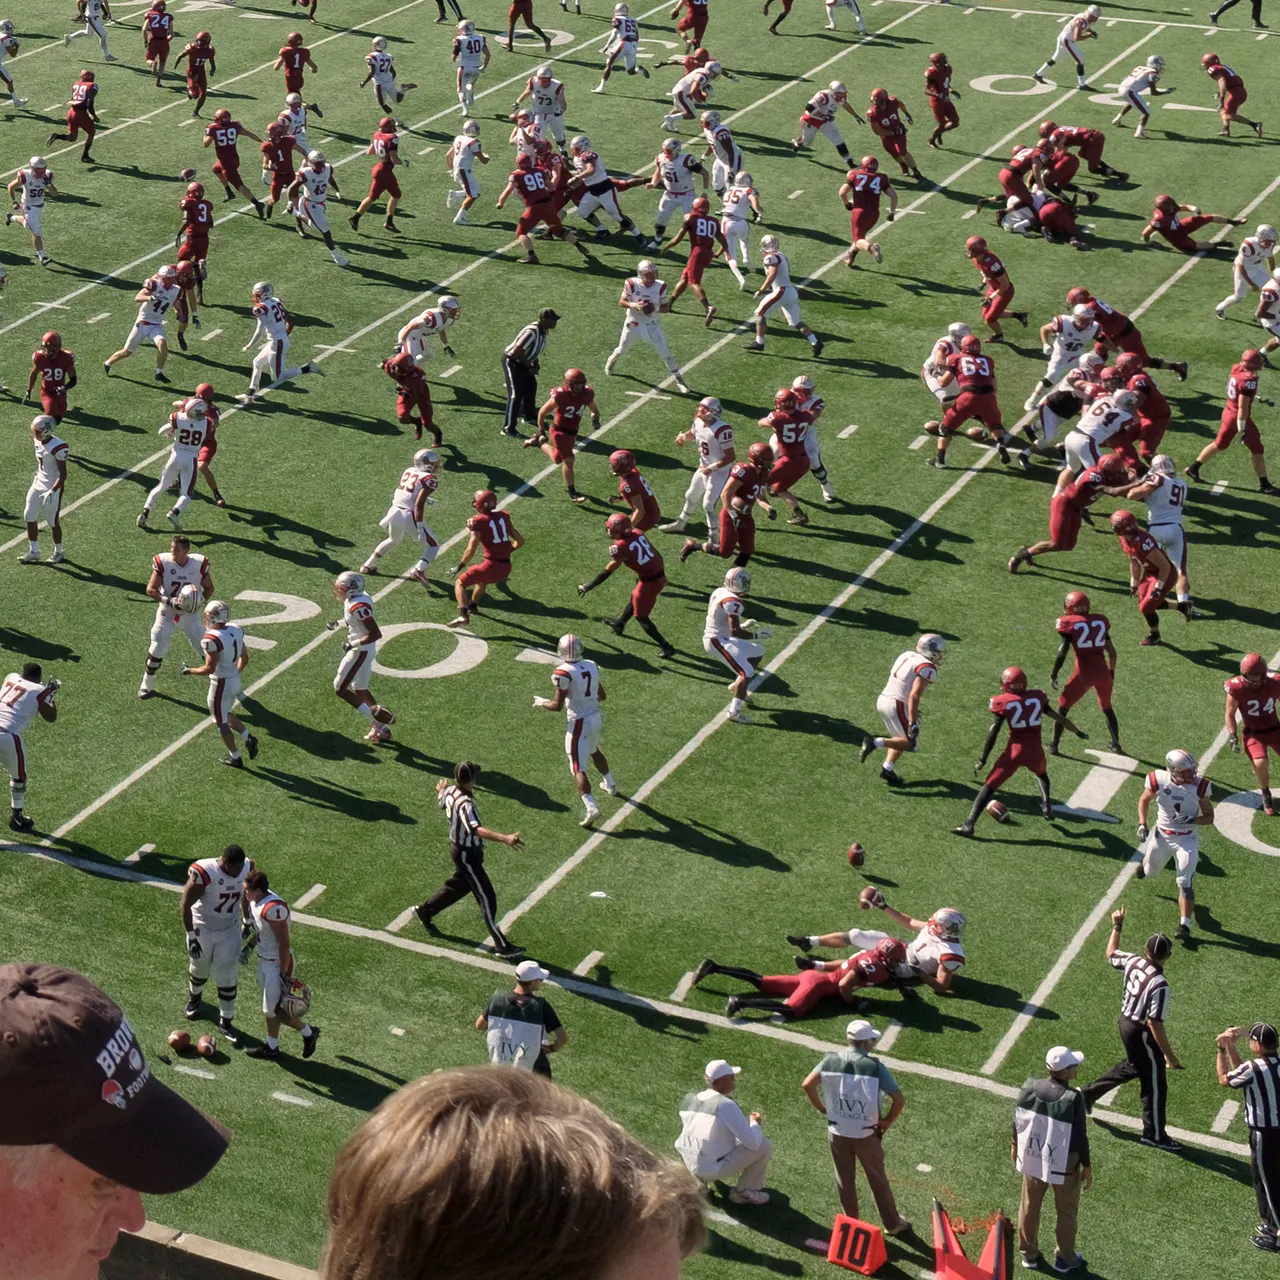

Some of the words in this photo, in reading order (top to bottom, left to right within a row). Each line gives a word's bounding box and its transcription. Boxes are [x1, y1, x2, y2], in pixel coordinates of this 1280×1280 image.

[151, 14, 168, 28] 24
[624, 19, 637, 32] 69
[466, 40, 482, 53] 40
[380, 59, 391, 72] 27
[217, 129, 236, 145] 59
[277, 150, 283, 161] 1
[524, 172, 543, 191] 96
[855, 175, 882, 194] 74
[198, 203, 208, 222] 3
[696, 218, 717, 237] 80
[43, 368, 63, 381] 28
[960, 357, 990, 377] 63
[178, 429, 201, 446] 28
[782, 423, 807, 443] 52
[490, 518, 508, 543] 11
[629, 537, 654, 565] 28
[1074, 622, 1107, 648] 22
[232, 639, 238, 662] 1
[582, 672, 592, 696] 7
[1008, 698, 1042, 728] 22
[218, 892, 240, 913] 77
[501, 1041, 530, 1056] IVY
[839, 1099, 868, 1112] IVY
[1028, 1136, 1057, 1157] IVY
[837, 1226, 872, 1263] 10
